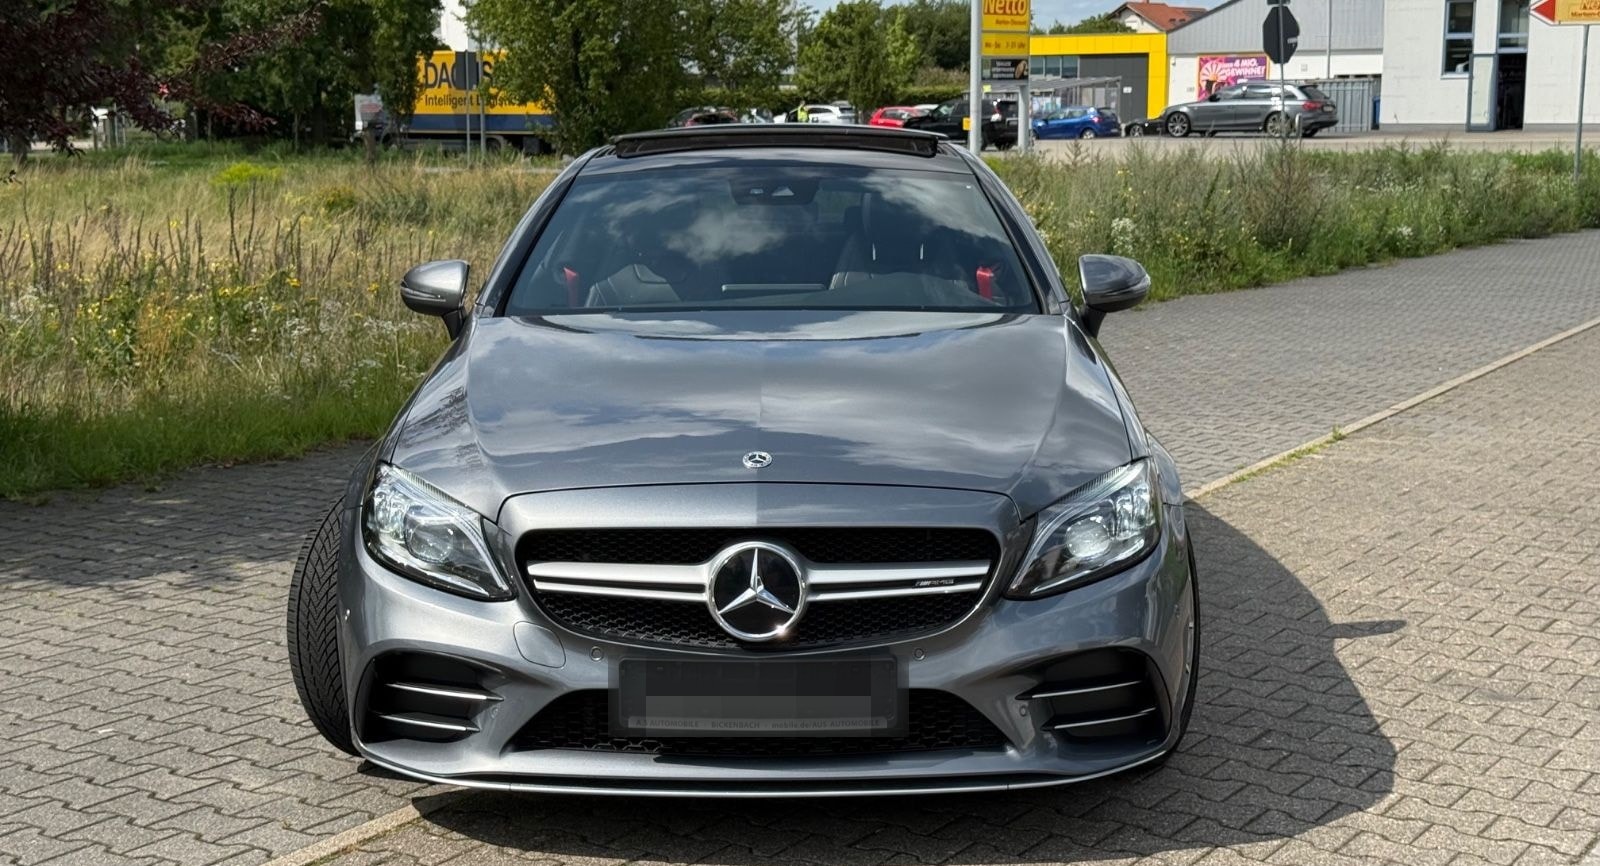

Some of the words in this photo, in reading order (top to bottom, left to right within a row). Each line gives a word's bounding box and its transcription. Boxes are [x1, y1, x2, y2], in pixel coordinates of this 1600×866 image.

[984, 0, 1027, 15] Netto
[649, 720, 699, 728] AUTOMOBILE
[711, 720, 760, 729] BICKENBACH
